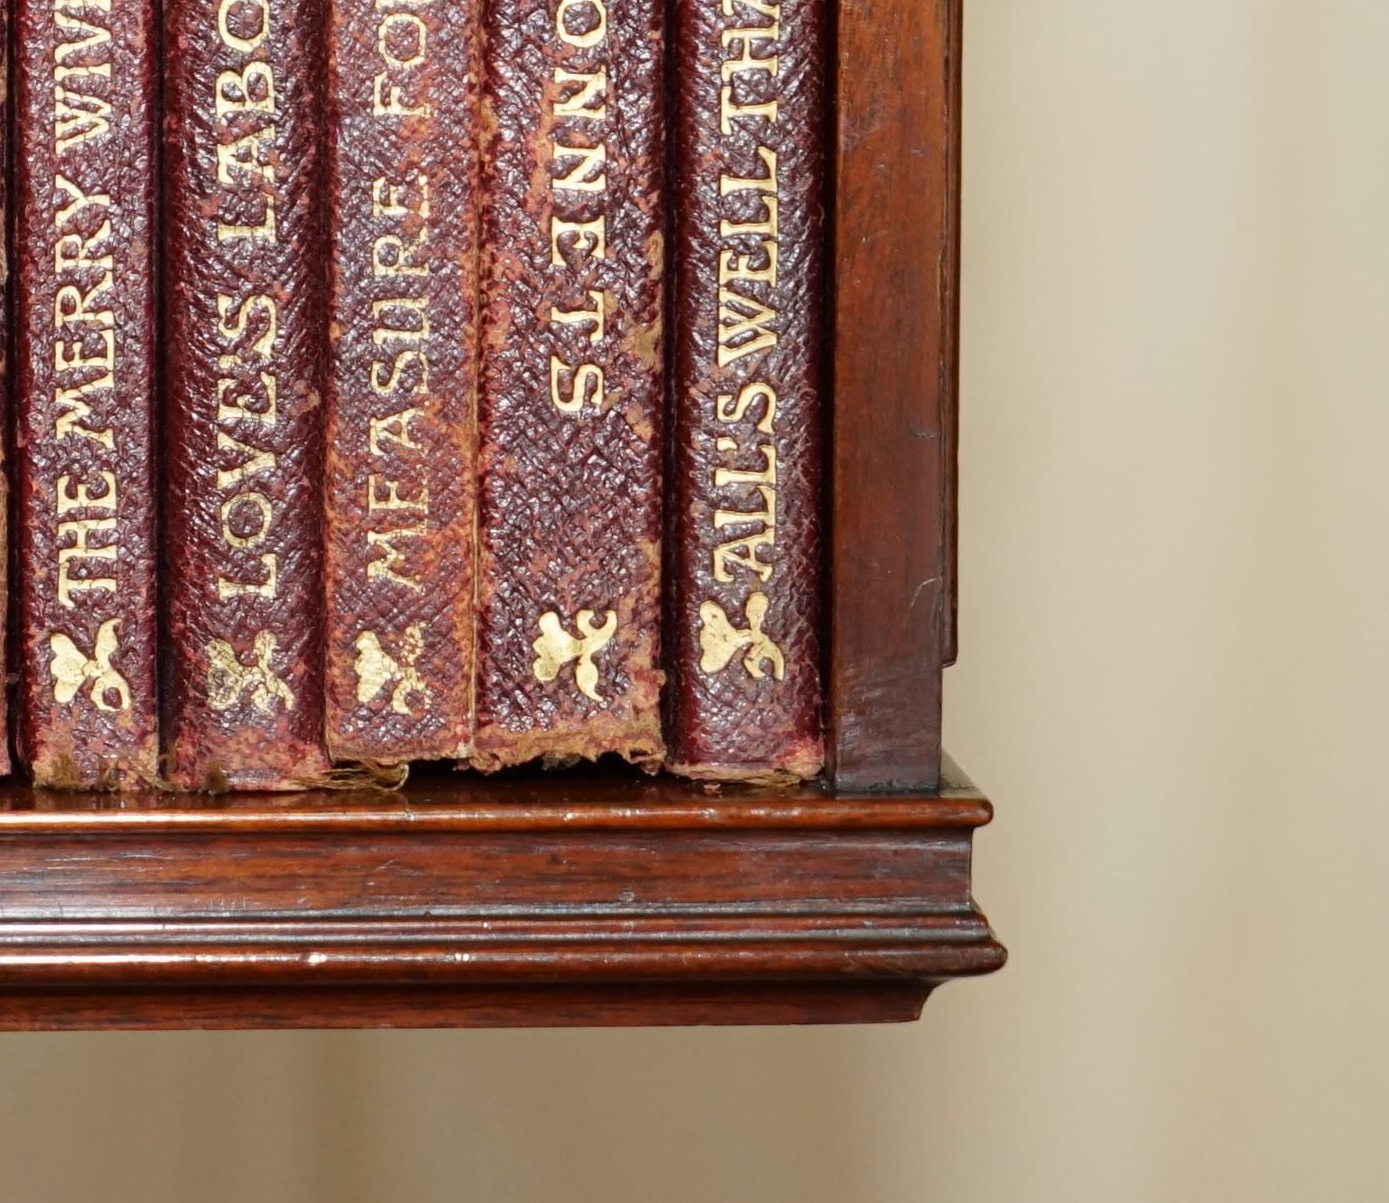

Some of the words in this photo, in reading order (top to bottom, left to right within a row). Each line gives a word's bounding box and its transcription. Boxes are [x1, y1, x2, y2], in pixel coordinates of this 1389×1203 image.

[55, 172, 114, 441] MERRY
[715, 144, 779, 366] WELL
[215, 293, 275, 601] LOVE'S
[366, 174, 429, 592] MEASURE
[713, 379, 776, 583] ALL'S
[57, 467, 116, 607] THE
